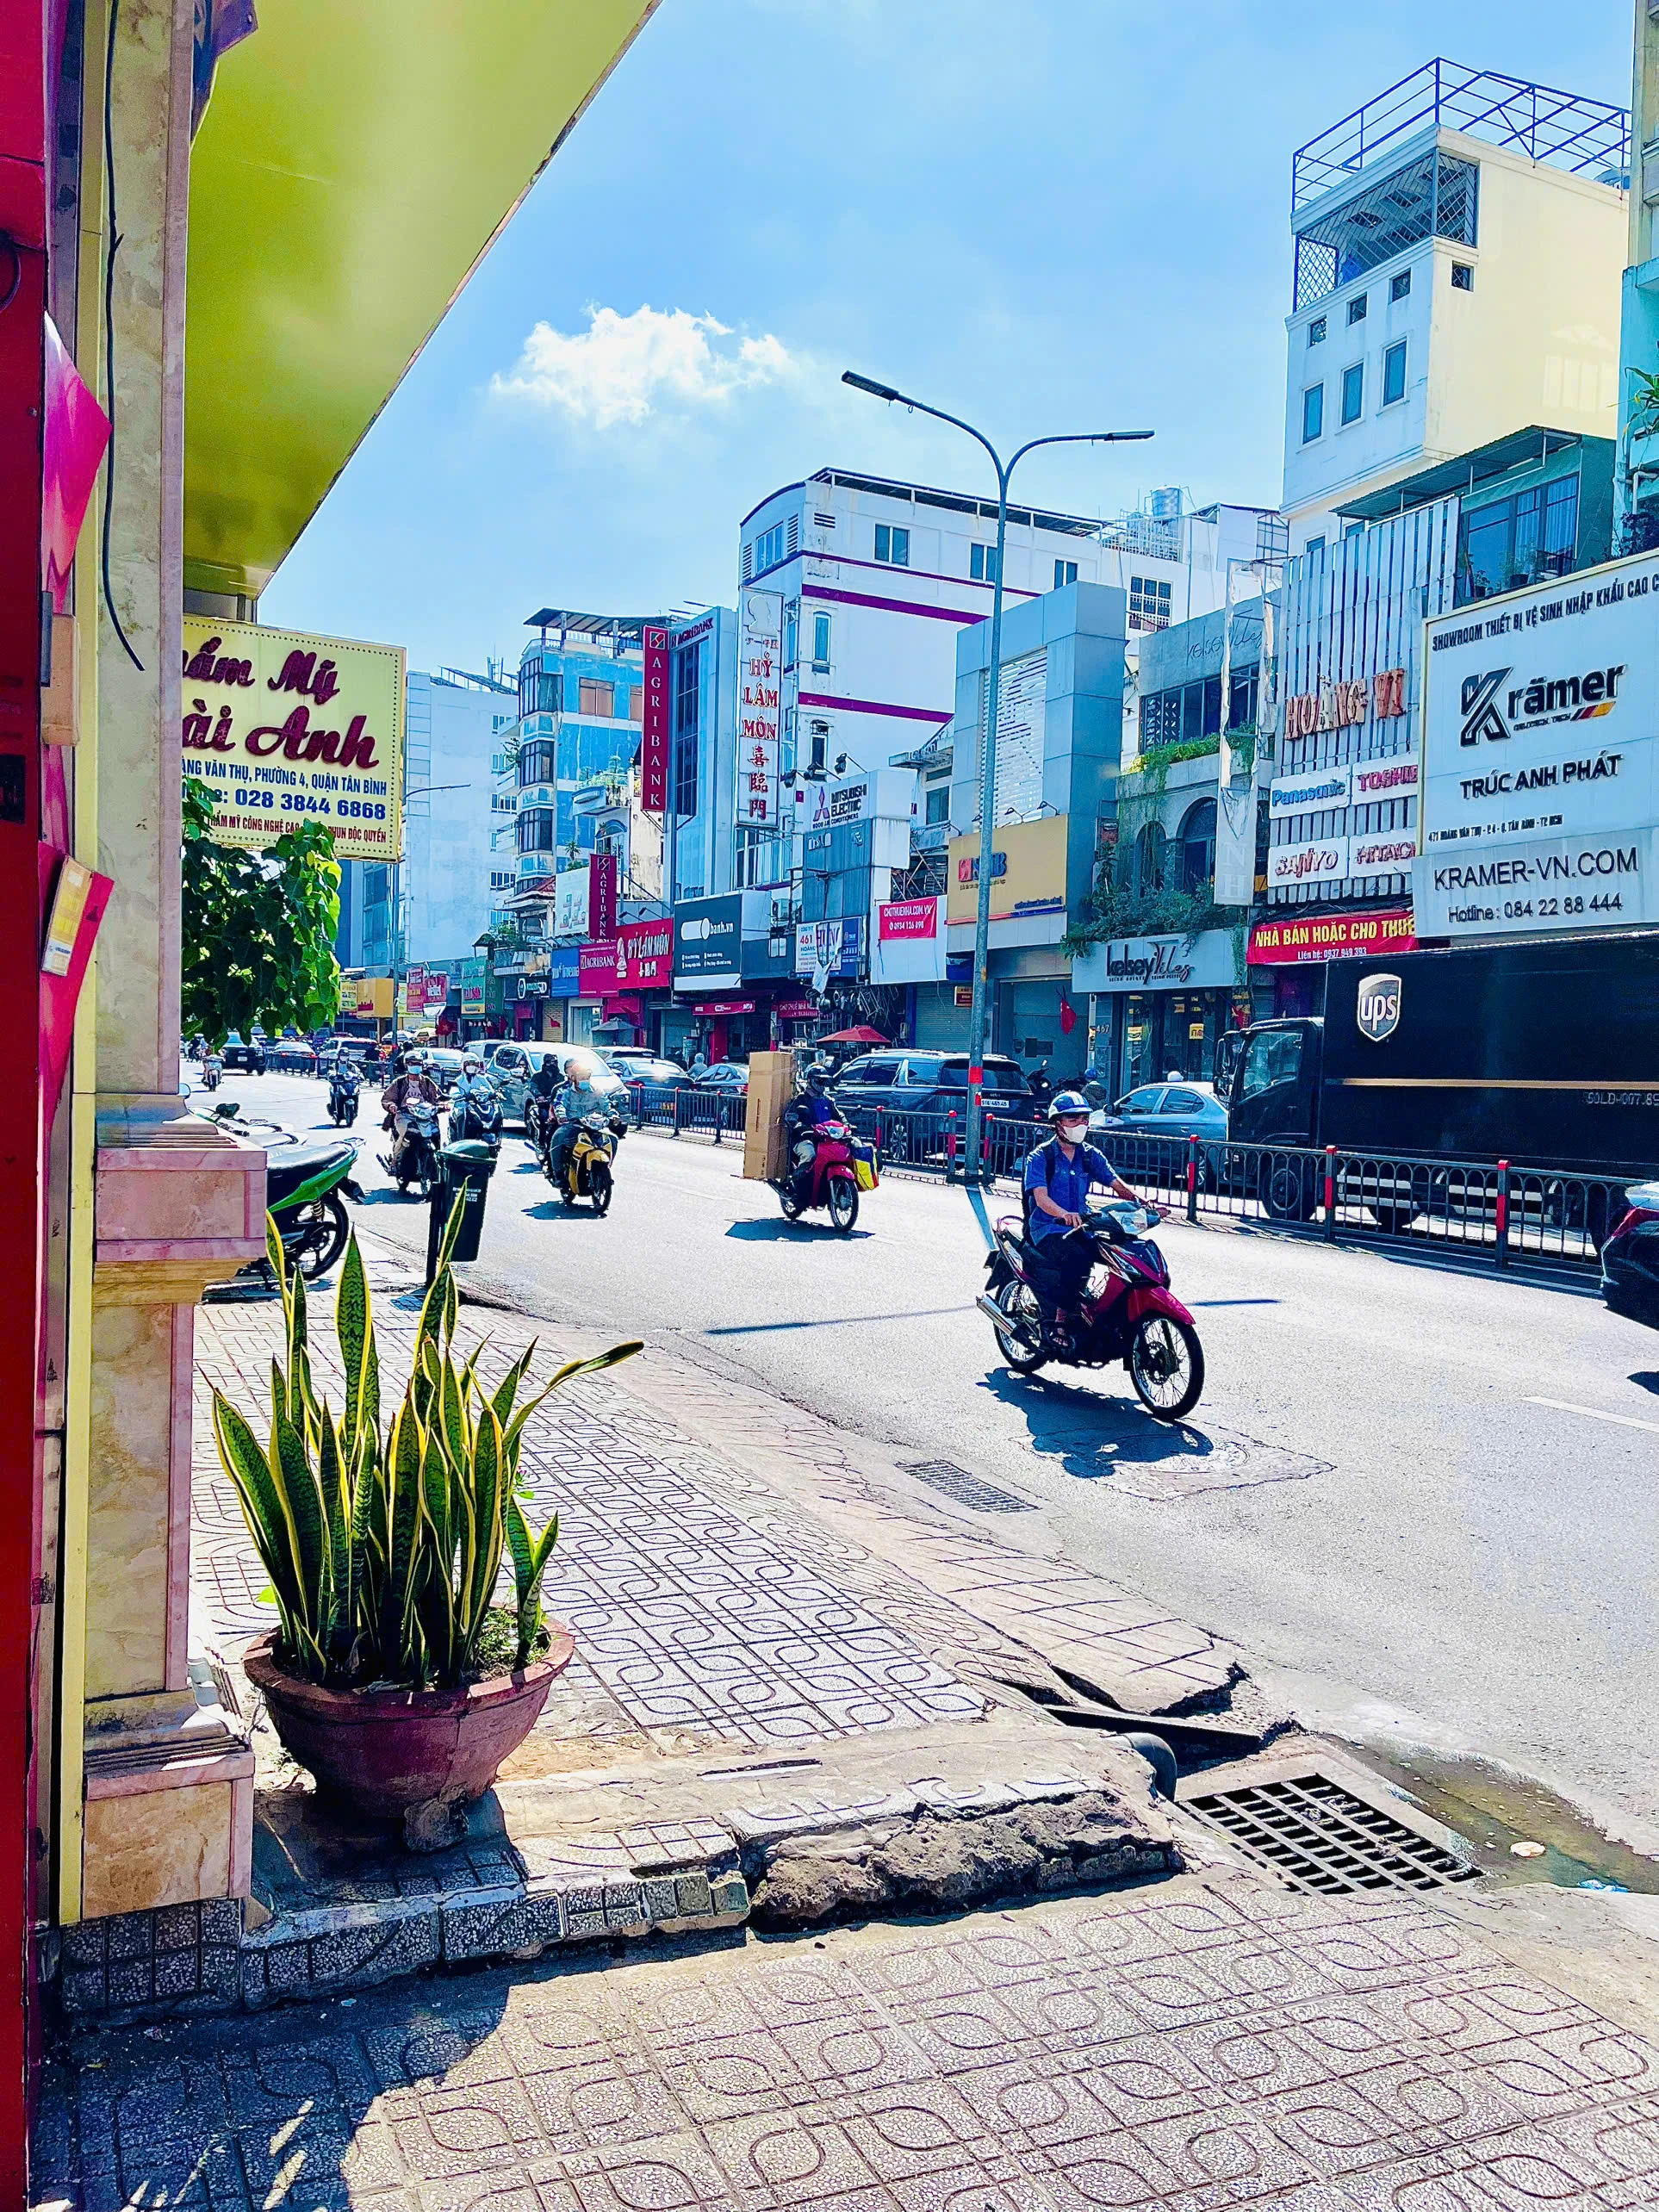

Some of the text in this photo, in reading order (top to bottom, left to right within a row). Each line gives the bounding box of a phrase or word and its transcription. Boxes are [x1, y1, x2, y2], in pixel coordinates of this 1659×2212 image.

[1432, 624, 1483, 651] SHOWROOM
[1485, 612, 1512, 637] THIẾT
[1513, 612, 1523, 631] BỊ
[1525, 605, 1538, 627] VỆ
[1539, 600, 1563, 622] SINH
[1566, 591, 1594, 615] NHẬP
[1627, 576, 1649, 598] CAO
[267, 649, 340, 705] Mỹ
[743, 682, 779, 708] LÂM
[1461, 665, 1626, 747] Krämer
[183, 699, 379, 768] ài Anh
[649, 656, 662, 806] AGRIBANK
[742, 716, 777, 741] MÔN
[205, 759, 227, 778] VĂN
[229, 764, 252, 783] THỤ,
[255, 766, 296, 786] PHƯỜNG
[312, 772, 339, 792] QUẬN
[341, 775, 360, 792] TÂN
[363, 777, 387, 796] BÌNH
[748, 745, 769, 820] 喜臨門
[1460, 750, 1624, 799] TRÚC ANH PHÁT
[235, 788, 274, 808] 028
[281, 793, 331, 814] 3844
[337, 799, 386, 820] 6868
[831, 784, 867, 804] MITSUBISHI
[831, 798, 861, 817] ELECTRIC
[1271, 779, 1345, 807] Panasonic
[972, 852, 1007, 880] SB
[1275, 848, 1339, 878] SANYO
[1434, 847, 1638, 891] KRAMER-VN.COM
[1504, 900, 1533, 918] 084
[1538, 898, 1559, 916] 22
[1563, 896, 1584, 915] 88
[1589, 892, 1623, 912] 444
[800, 935, 812, 944] 461
[1255, 926, 1279, 947] NHÀ
[1283, 924, 1308, 945] BÁN
[1313, 922, 1346, 945] HOẶC
[1350, 921, 1377, 940] CHO
[586, 955, 615, 968] AGRIBANK
[1107, 943, 1155, 985] kelsey
[1324, 948, 1339, 959] 0937
[1361, 995, 1397, 1031] ups
